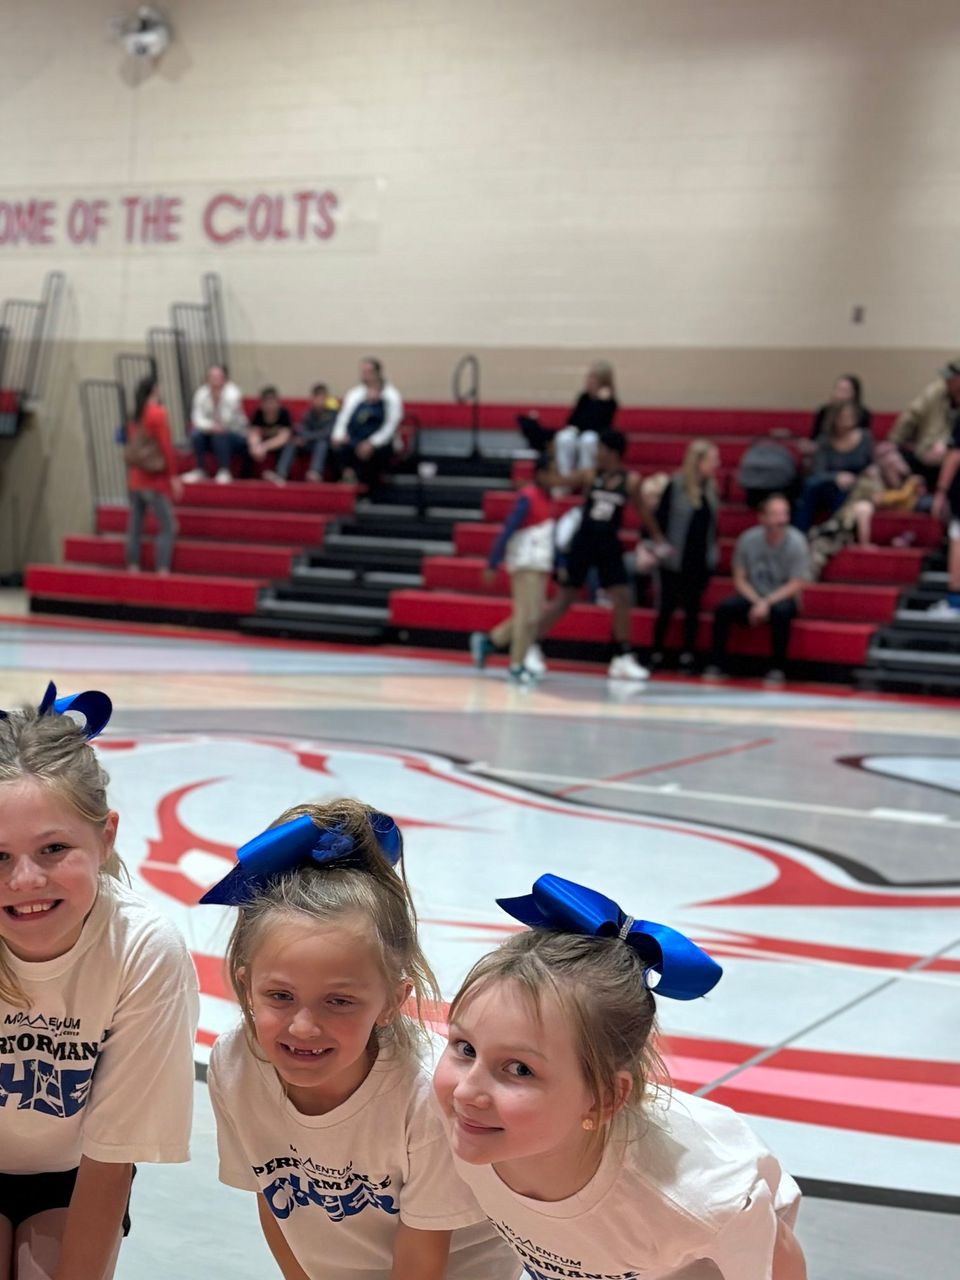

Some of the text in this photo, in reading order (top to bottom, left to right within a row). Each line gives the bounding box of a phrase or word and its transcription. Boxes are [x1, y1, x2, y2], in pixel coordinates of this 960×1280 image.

[66, 199, 108, 244] OF
[120, 197, 181, 242] THE
[201, 191, 338, 244] COLTS
[4, 1012, 80, 1031] MOMEUM
[251, 1156, 392, 1191] PERFRMANE
